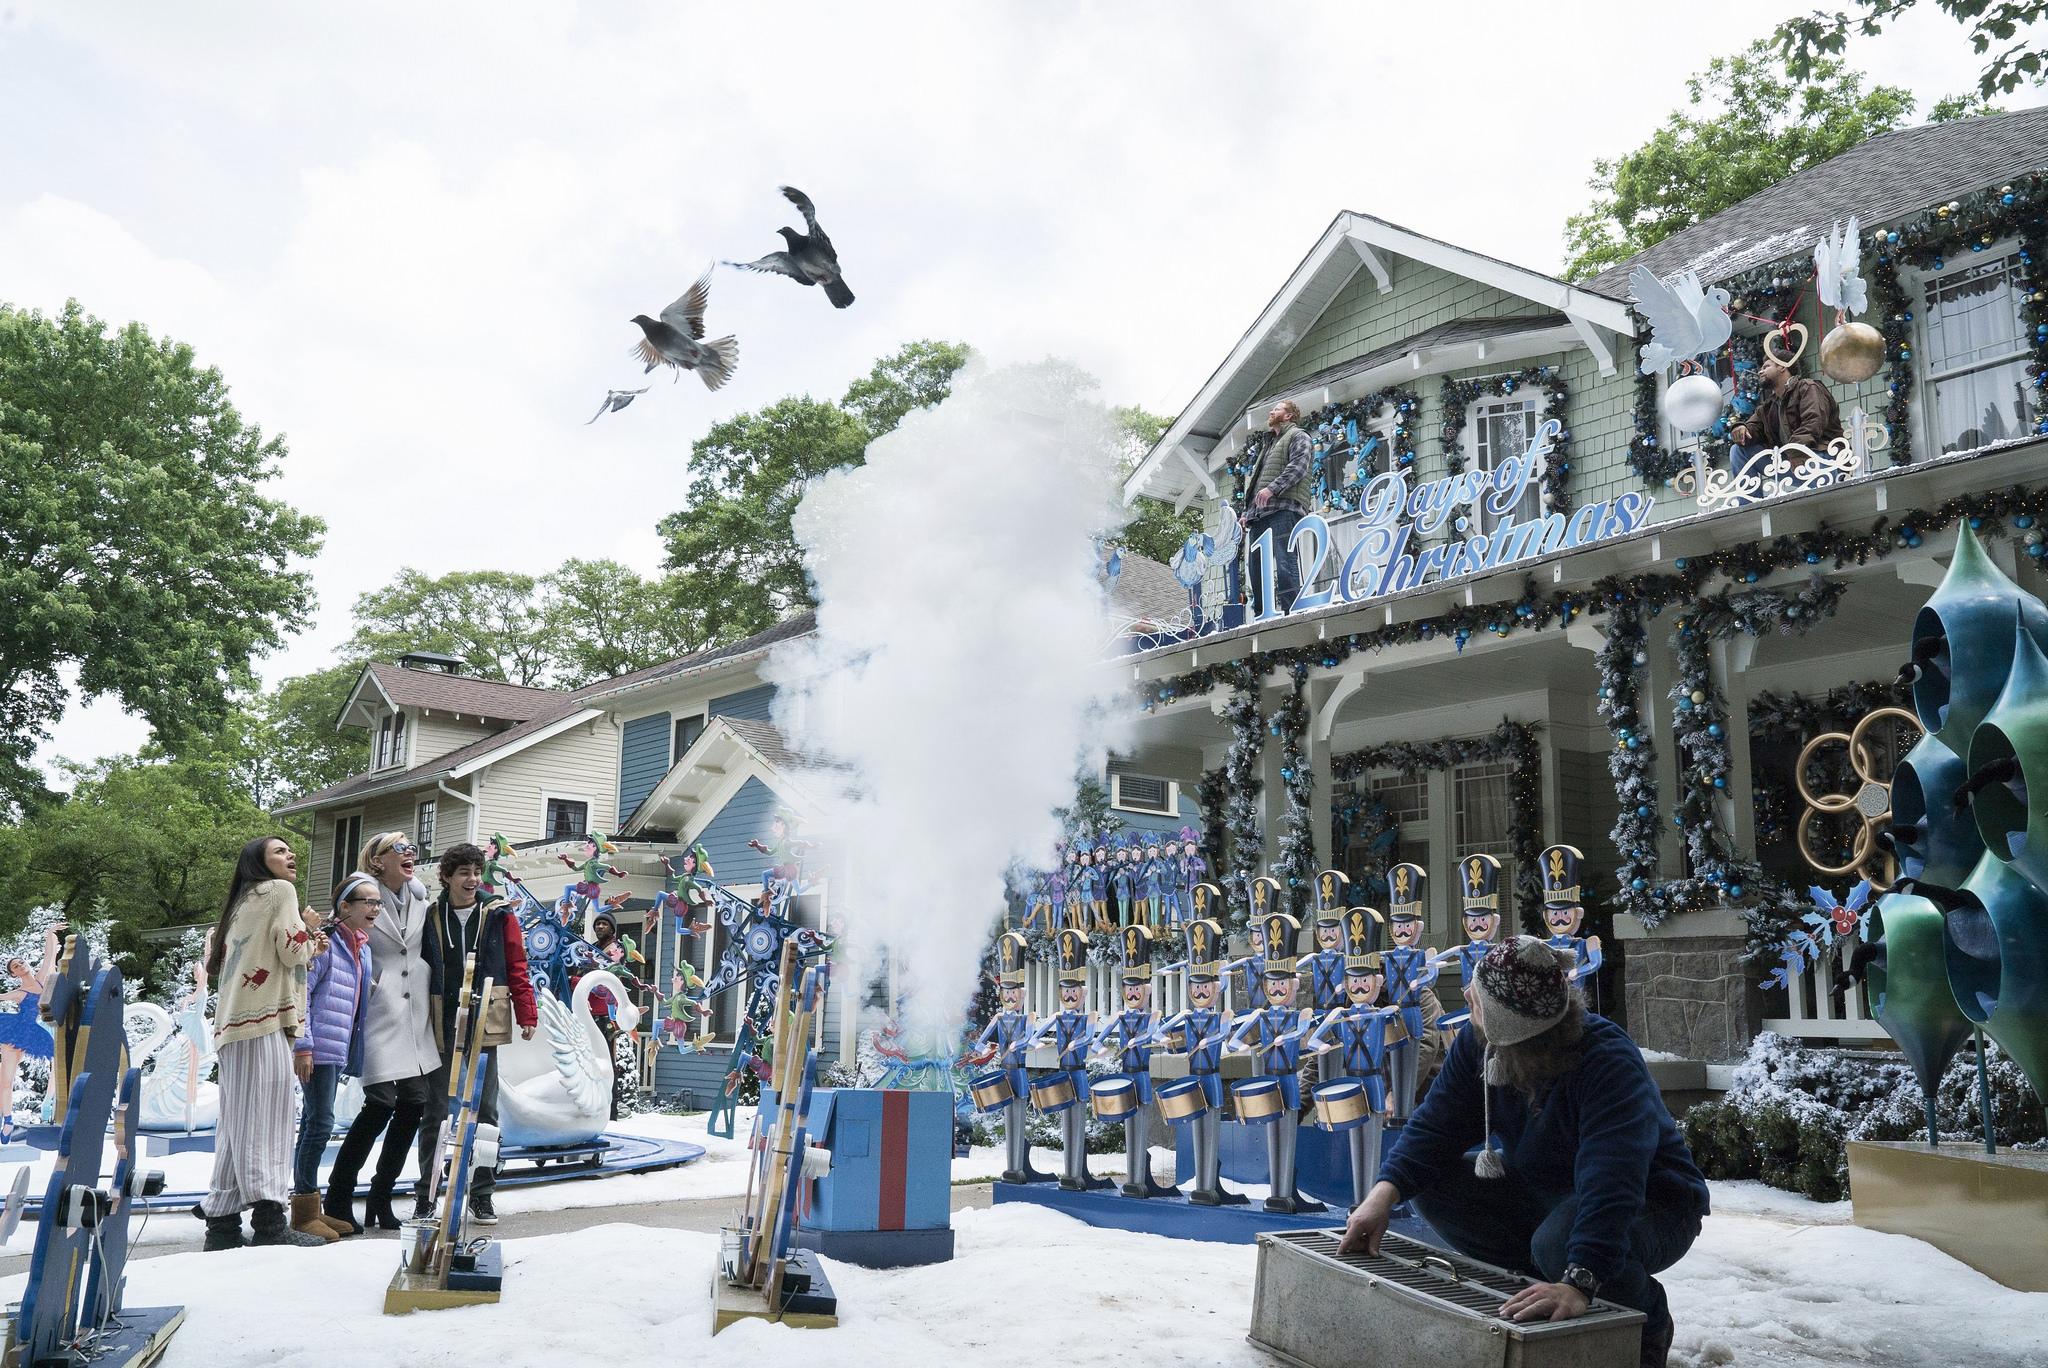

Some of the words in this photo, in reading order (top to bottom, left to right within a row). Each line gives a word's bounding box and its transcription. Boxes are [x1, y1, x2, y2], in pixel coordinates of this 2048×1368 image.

[1358, 466, 1490, 535] Days
[1486, 418, 1562, 515] of
[1250, 514, 1337, 621] 12
[1339, 492, 1656, 603] Christmas
